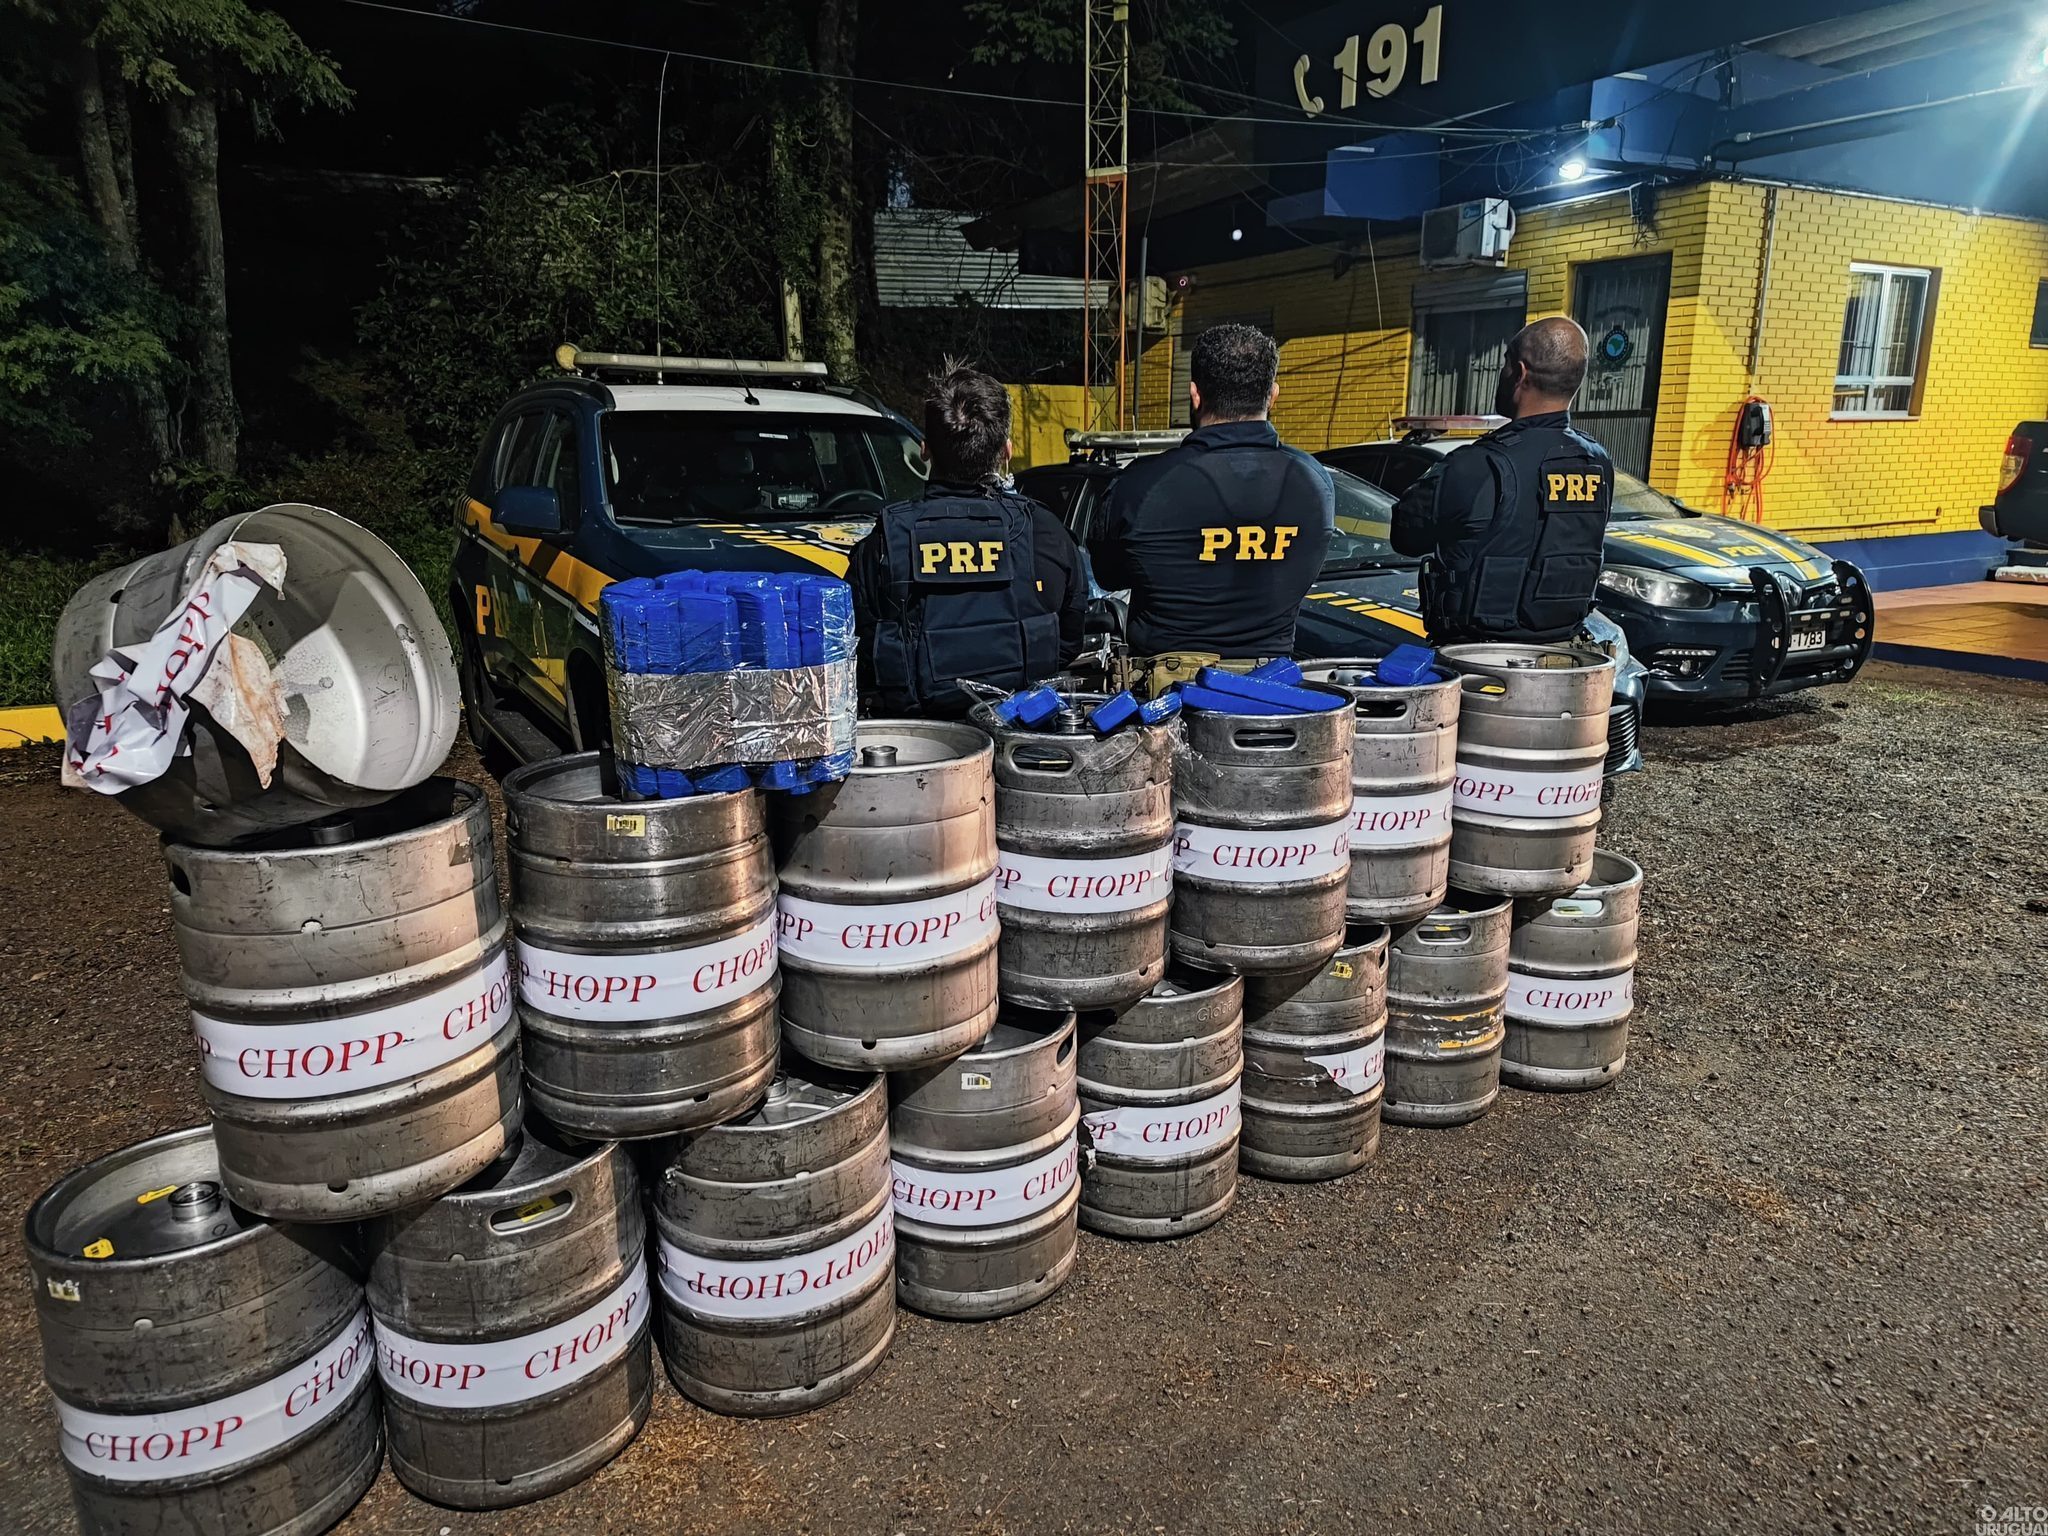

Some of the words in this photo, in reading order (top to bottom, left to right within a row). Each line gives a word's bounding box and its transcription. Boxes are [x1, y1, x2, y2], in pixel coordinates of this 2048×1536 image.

[1333, 4, 1443, 110] 191
[1546, 473, 1601, 502] PRF
[919, 541, 1004, 574] PRF
[1198, 525, 1299, 562] PRF
[1213, 843, 1317, 868] CHOPP
[1047, 869, 1151, 898] CHOPP
[841, 911, 961, 949] CHOPP
[1525, 988, 1613, 1010] CHOPP
[238, 1031, 404, 1079] CHOPP
[1142, 1104, 1230, 1143] CHOPP
[892, 1178, 996, 1212] CHOPP
[687, 1268, 809, 1301] CHOPP
[379, 1340, 486, 1390] CHOPP
[524, 1292, 638, 1379] CHOPP
[85, 1416, 244, 1463] CHOPP
